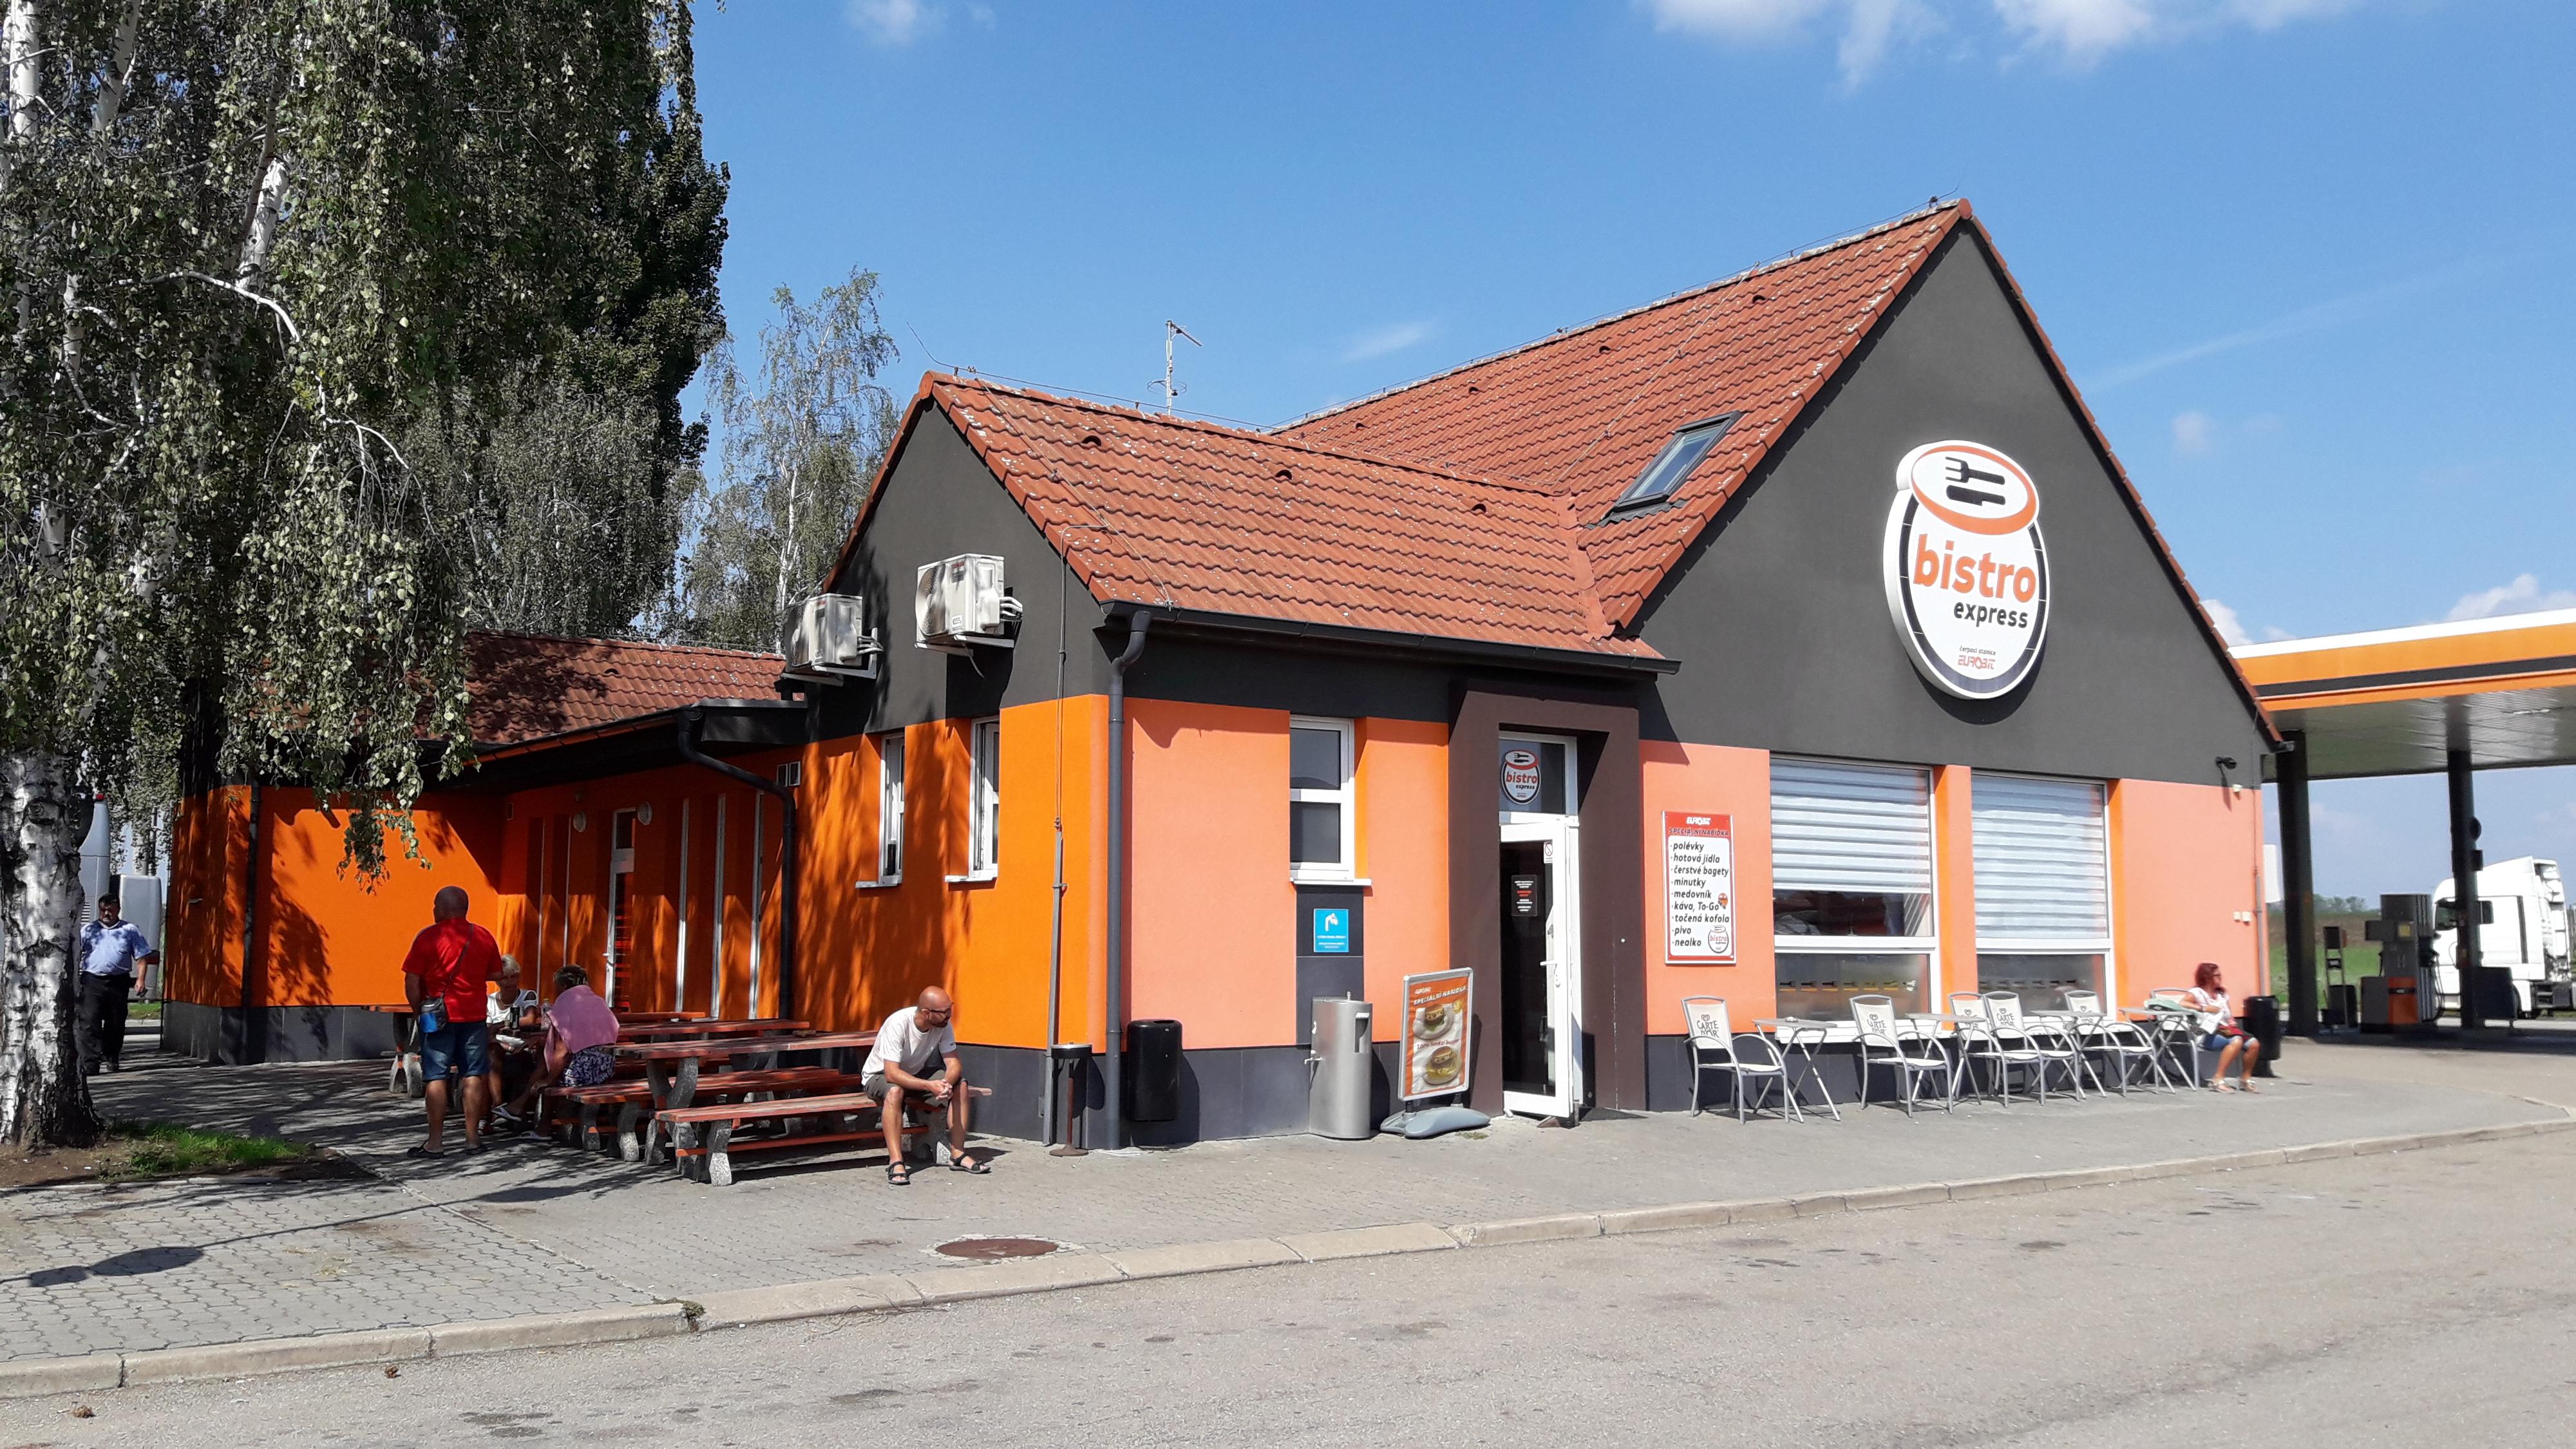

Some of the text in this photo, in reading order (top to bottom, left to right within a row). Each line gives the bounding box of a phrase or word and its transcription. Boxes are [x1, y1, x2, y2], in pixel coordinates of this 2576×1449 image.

[1913, 534, 2036, 603] bistro
[1954, 601, 2028, 628] express
[1506, 772, 1538, 784] bistro
[1673, 841, 1705, 853] polévky
[1673, 853, 1720, 864] hotová jídla
[1674, 866, 1728, 877] čerstvé bagety
[1674, 877, 1706, 889] minutky
[1674, 889, 1712, 899] medovník
[1674, 901, 1719, 913] káva, To-Go
[1674, 913, 1730, 923] točená kofola
[1674, 926, 1692, 937] pivo
[1674, 938, 1701, 947] nealko
[1696, 1020, 1719, 1031] CARTE
